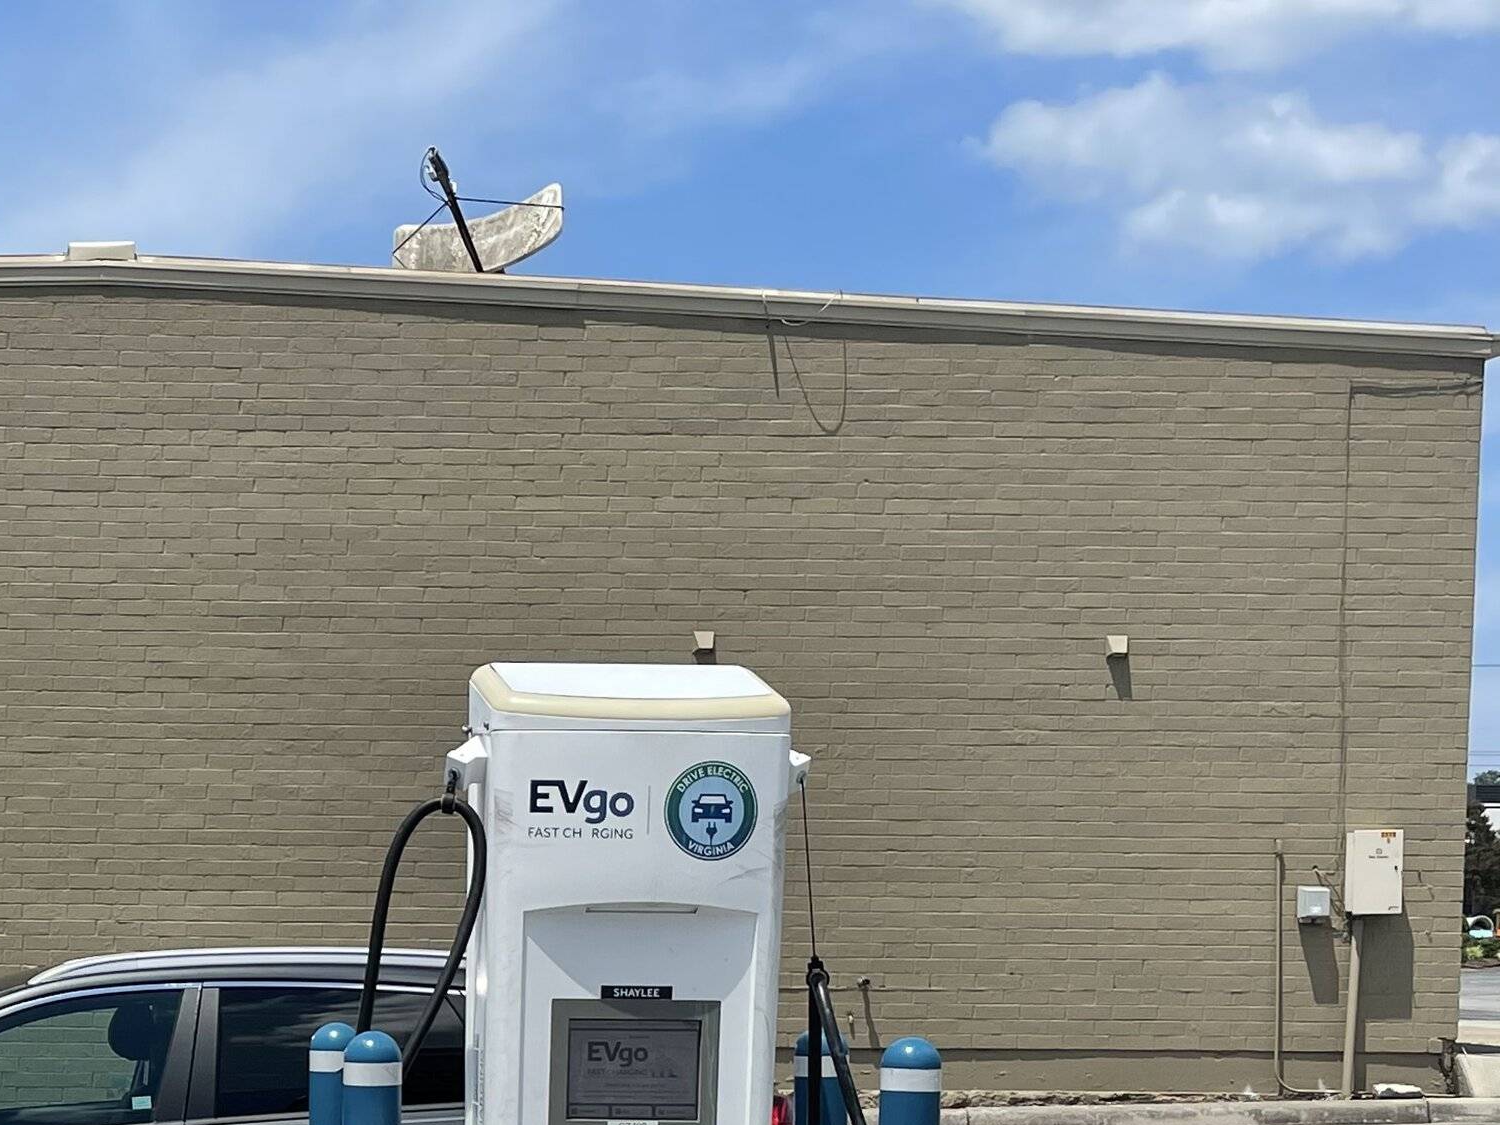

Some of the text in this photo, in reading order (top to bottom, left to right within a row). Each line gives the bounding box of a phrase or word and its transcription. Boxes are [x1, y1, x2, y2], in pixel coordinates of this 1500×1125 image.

[676, 765, 749, 793] DRIVE ELECTRIC
[529, 779, 635, 825] EVgo
[527, 827, 558, 839] FAST
[688, 840, 735, 856] VIRGINIA
[613, 987, 661, 998] SHAYLEE
[587, 1041, 649, 1067] EVgo
